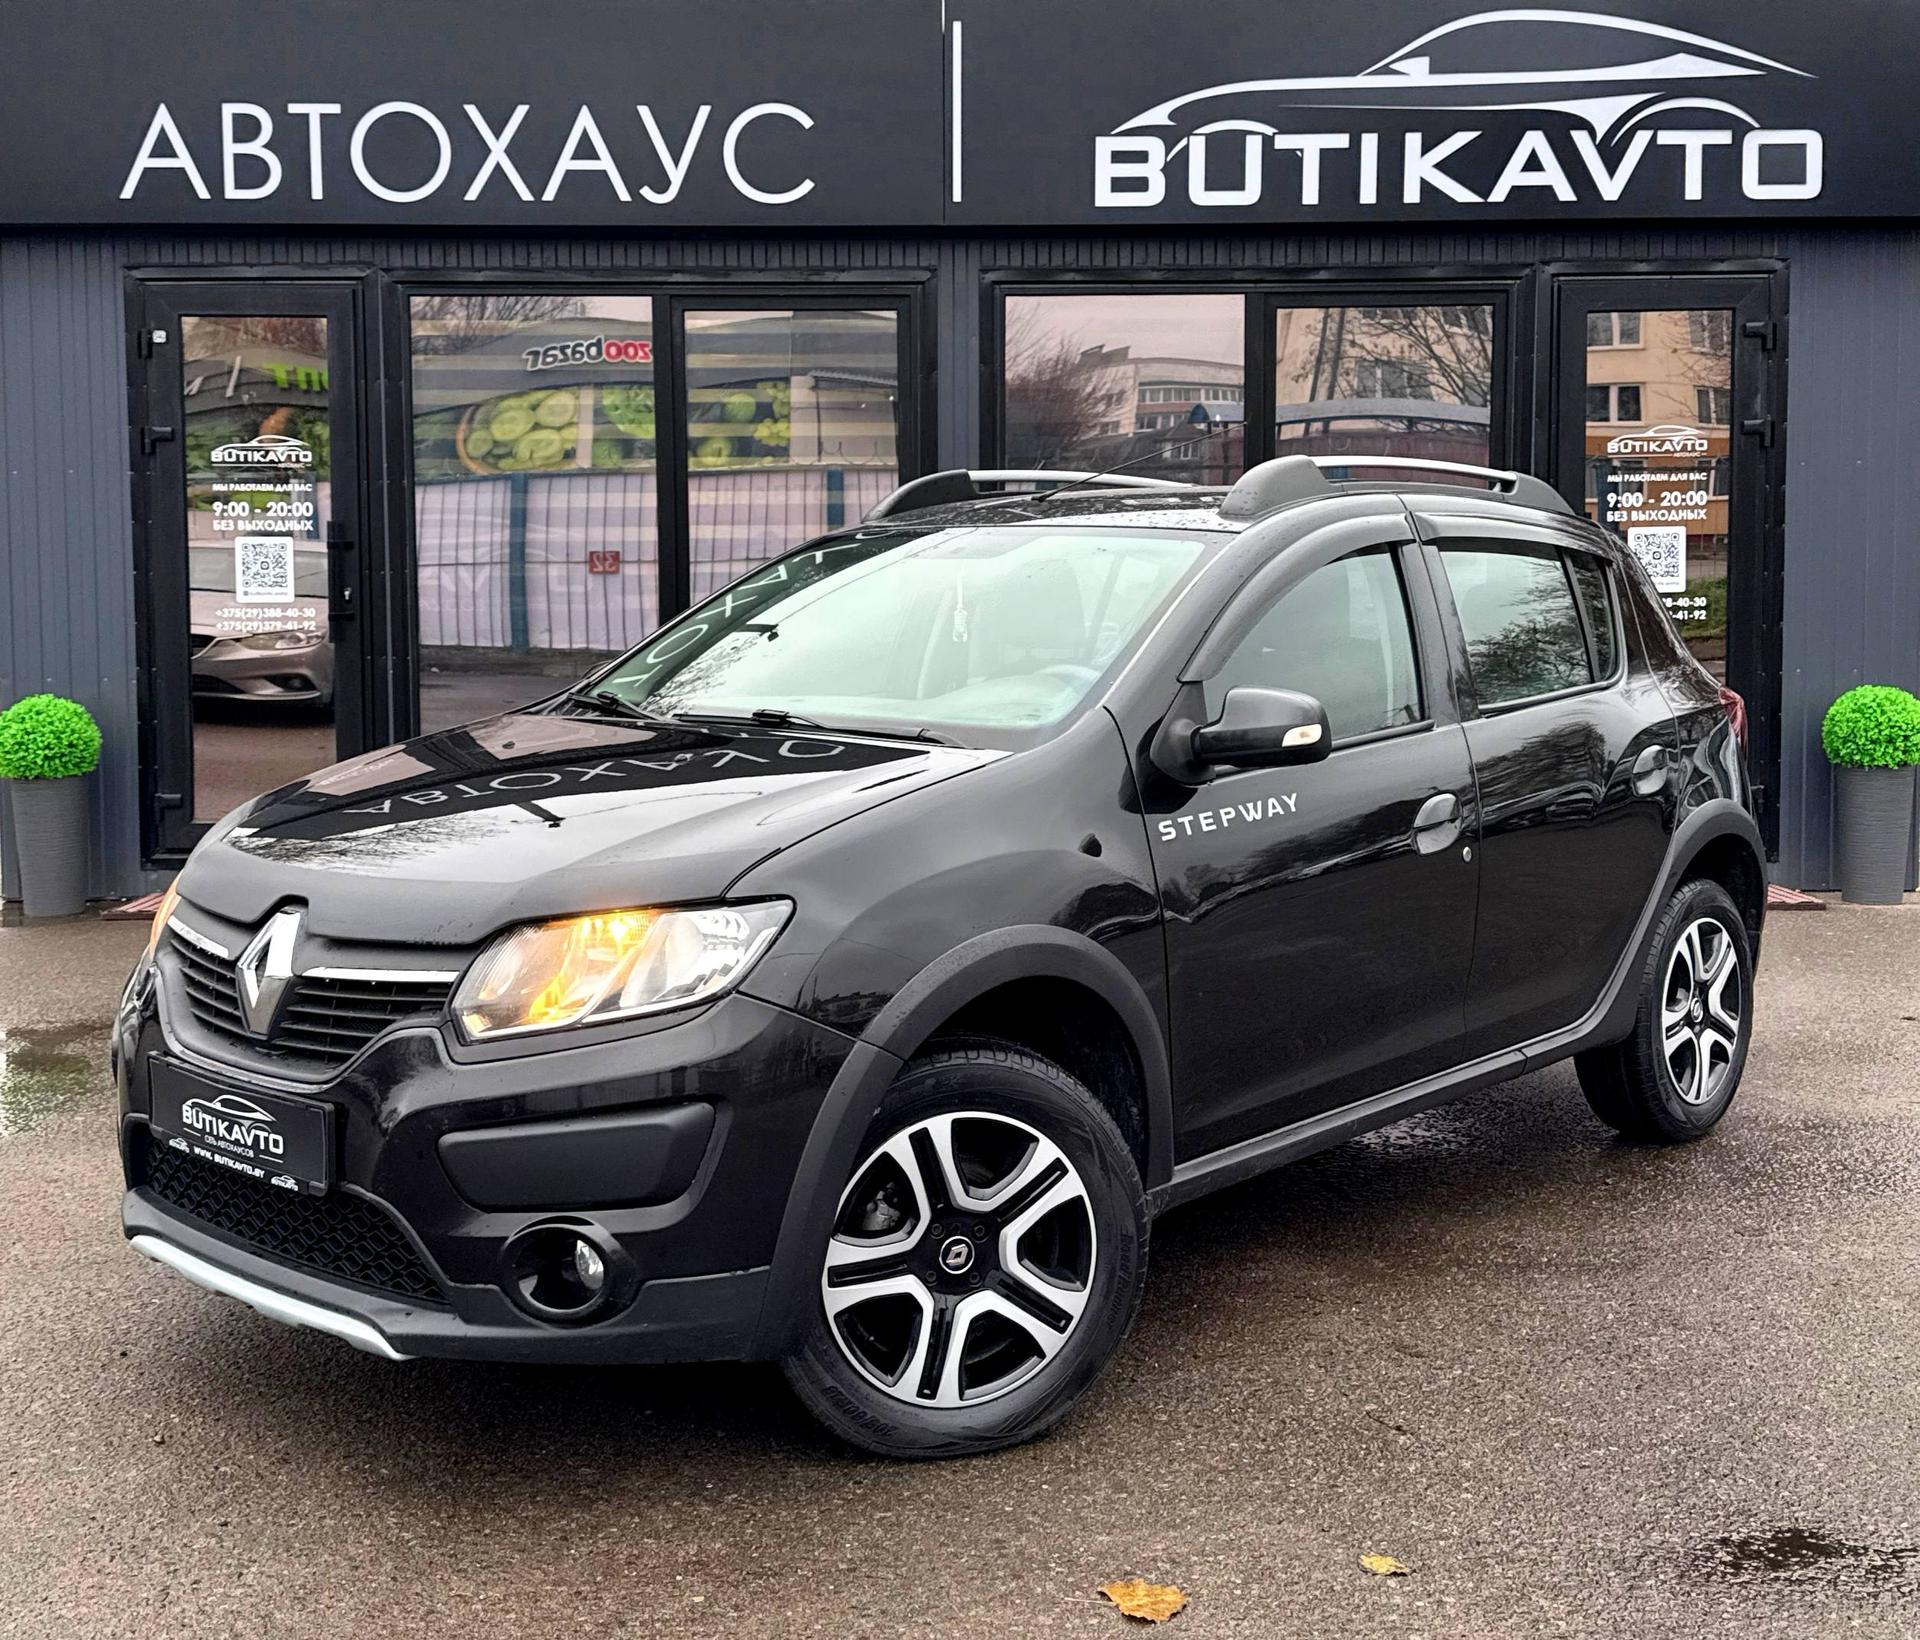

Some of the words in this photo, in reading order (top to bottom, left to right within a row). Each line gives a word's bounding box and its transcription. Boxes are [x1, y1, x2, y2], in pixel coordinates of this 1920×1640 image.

[119, 101, 816, 205] АВТОХАУС
[1094, 128, 1824, 208] BUTIKAVTO
[1606, 440, 1708, 453] BUTIKAVTO
[210, 450, 313, 462] BUTIKAVTO
[1607, 474, 1622, 482] МЫ
[1624, 473, 1668, 482] РАБОТАЕМ
[1670, 473, 1688, 481] ДЛЯ
[1689, 472, 1708, 480] ВАС
[212, 483, 228, 491] МЫ
[229, 483, 274, 491] РАБОТАЕМ
[275, 483, 293, 492] ДЛЯ
[294, 483, 313, 491] ВАС
[1607, 492, 1643, 508] 9:00
[1660, 490, 1708, 507] 20:00
[212, 501, 250, 517] 9:00
[266, 501, 314, 517] 20:00
[1606, 511, 1628, 522] БЕЗ
[1631, 509, 1707, 521] ВЫХОДНЫХ
[212, 520, 235, 531] БЕЗ
[237, 520, 314, 532] ВЫХОДНЫХ
[215, 607, 317, 620] +375(29)388-40-30
[215, 620, 317, 633] +375(29)379-41-92
[1158, 792, 1298, 842] STEPWAY
[182, 1104, 284, 1154] BUTIKAVTO
